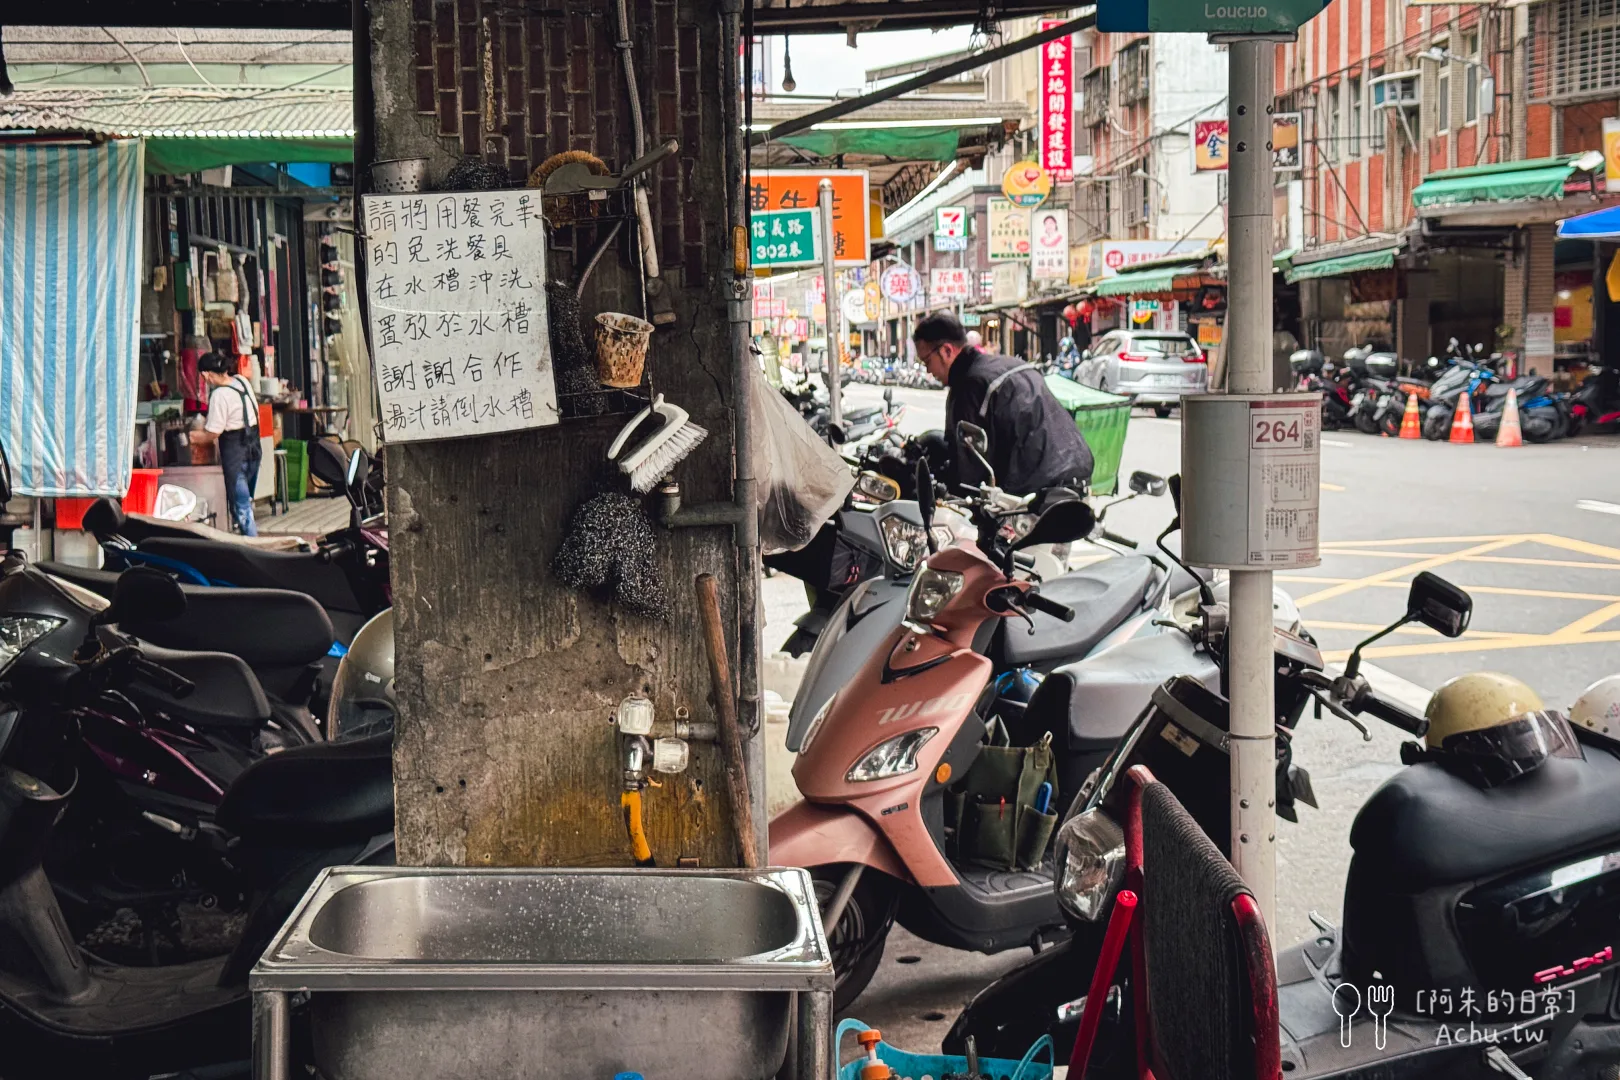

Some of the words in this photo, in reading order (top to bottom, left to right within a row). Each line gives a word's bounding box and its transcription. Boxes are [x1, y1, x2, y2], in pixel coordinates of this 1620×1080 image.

[1203, 3, 1267, 18] Loucuo
[368, 195, 535, 232] 請將用餐完畢
[752, 217, 805, 239] 信義路
[373, 234, 513, 266] 的免洗餐具
[756, 240, 802, 260] 302巷
[375, 267, 533, 300] 在水槽沖洗
[378, 302, 532, 349] 置放於水槽
[382, 351, 523, 392] 謝謝合作
[386, 387, 534, 431] 湯汁請倒水槽
[1255, 420, 1300, 443] 264
